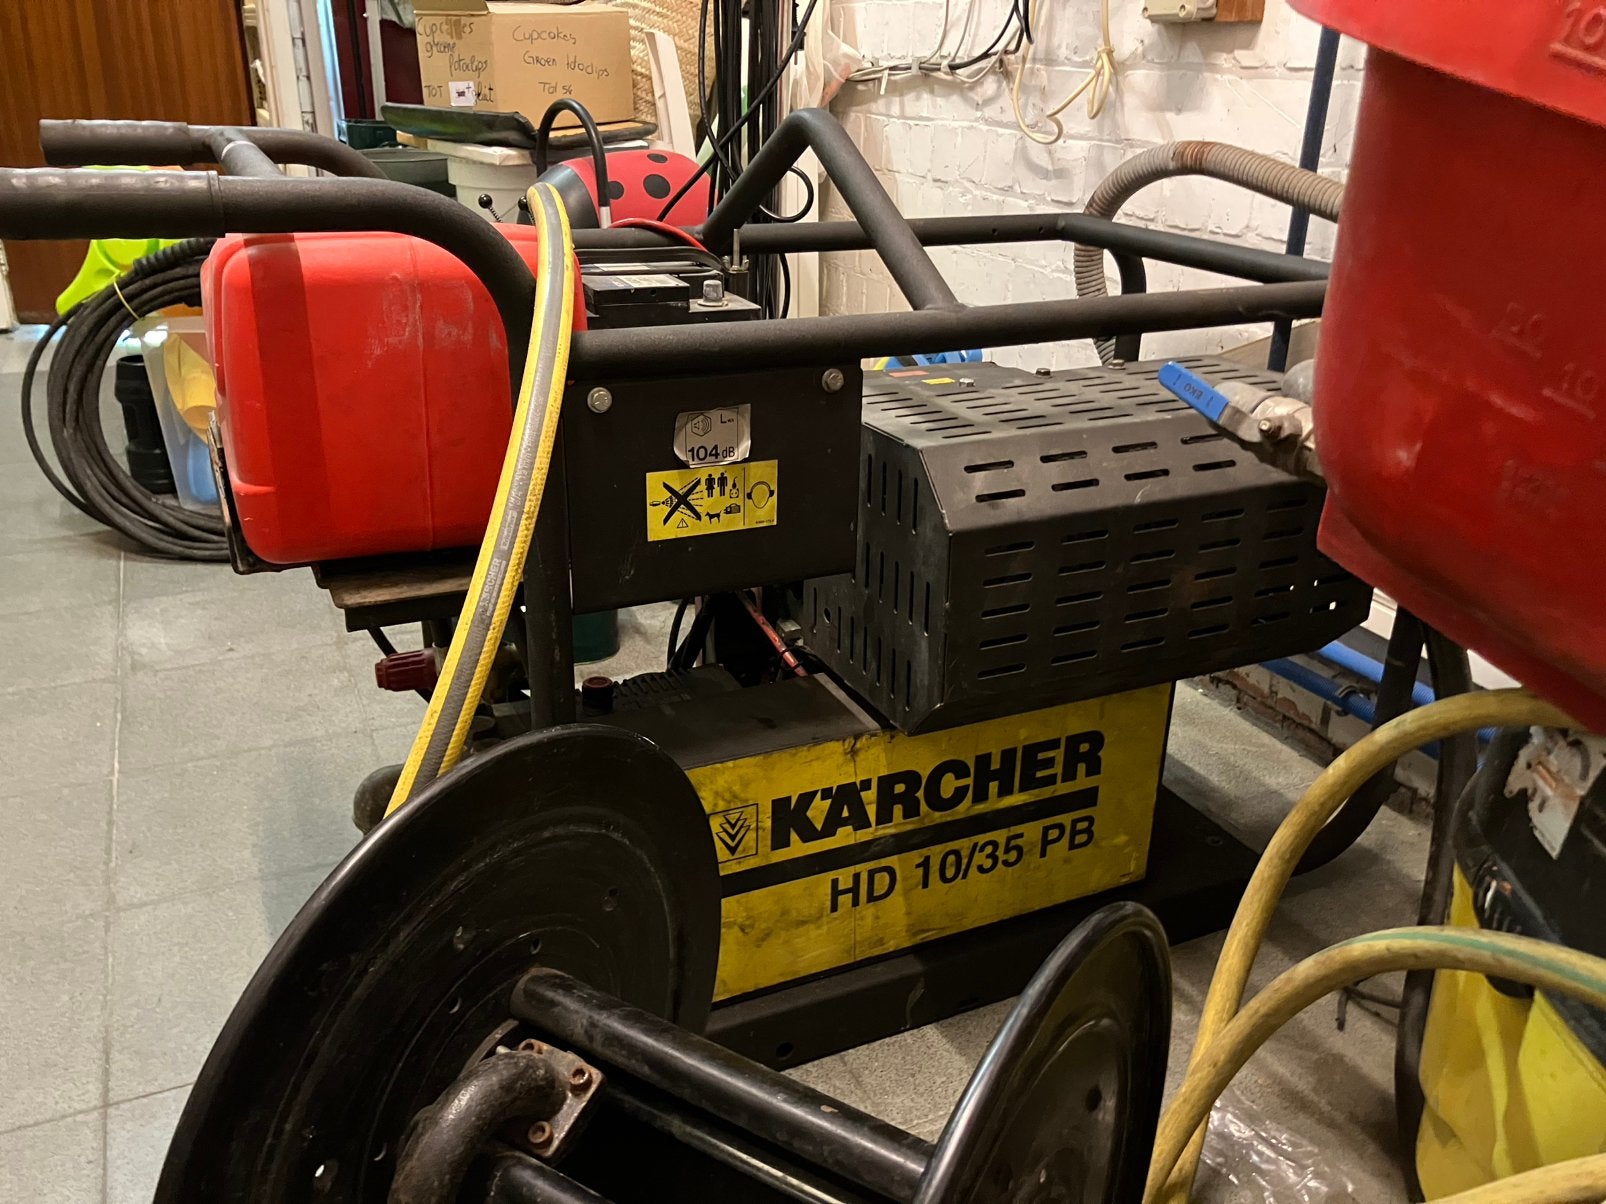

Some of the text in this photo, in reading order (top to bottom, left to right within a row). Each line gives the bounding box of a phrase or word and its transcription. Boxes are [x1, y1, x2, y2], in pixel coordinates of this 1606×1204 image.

[417, 16, 475, 44] Cupces
[687, 444, 736, 462] 104 dB
[770, 730, 1105, 851] KÄRCHER
[829, 814, 1096, 914] HD 10/35 PB
